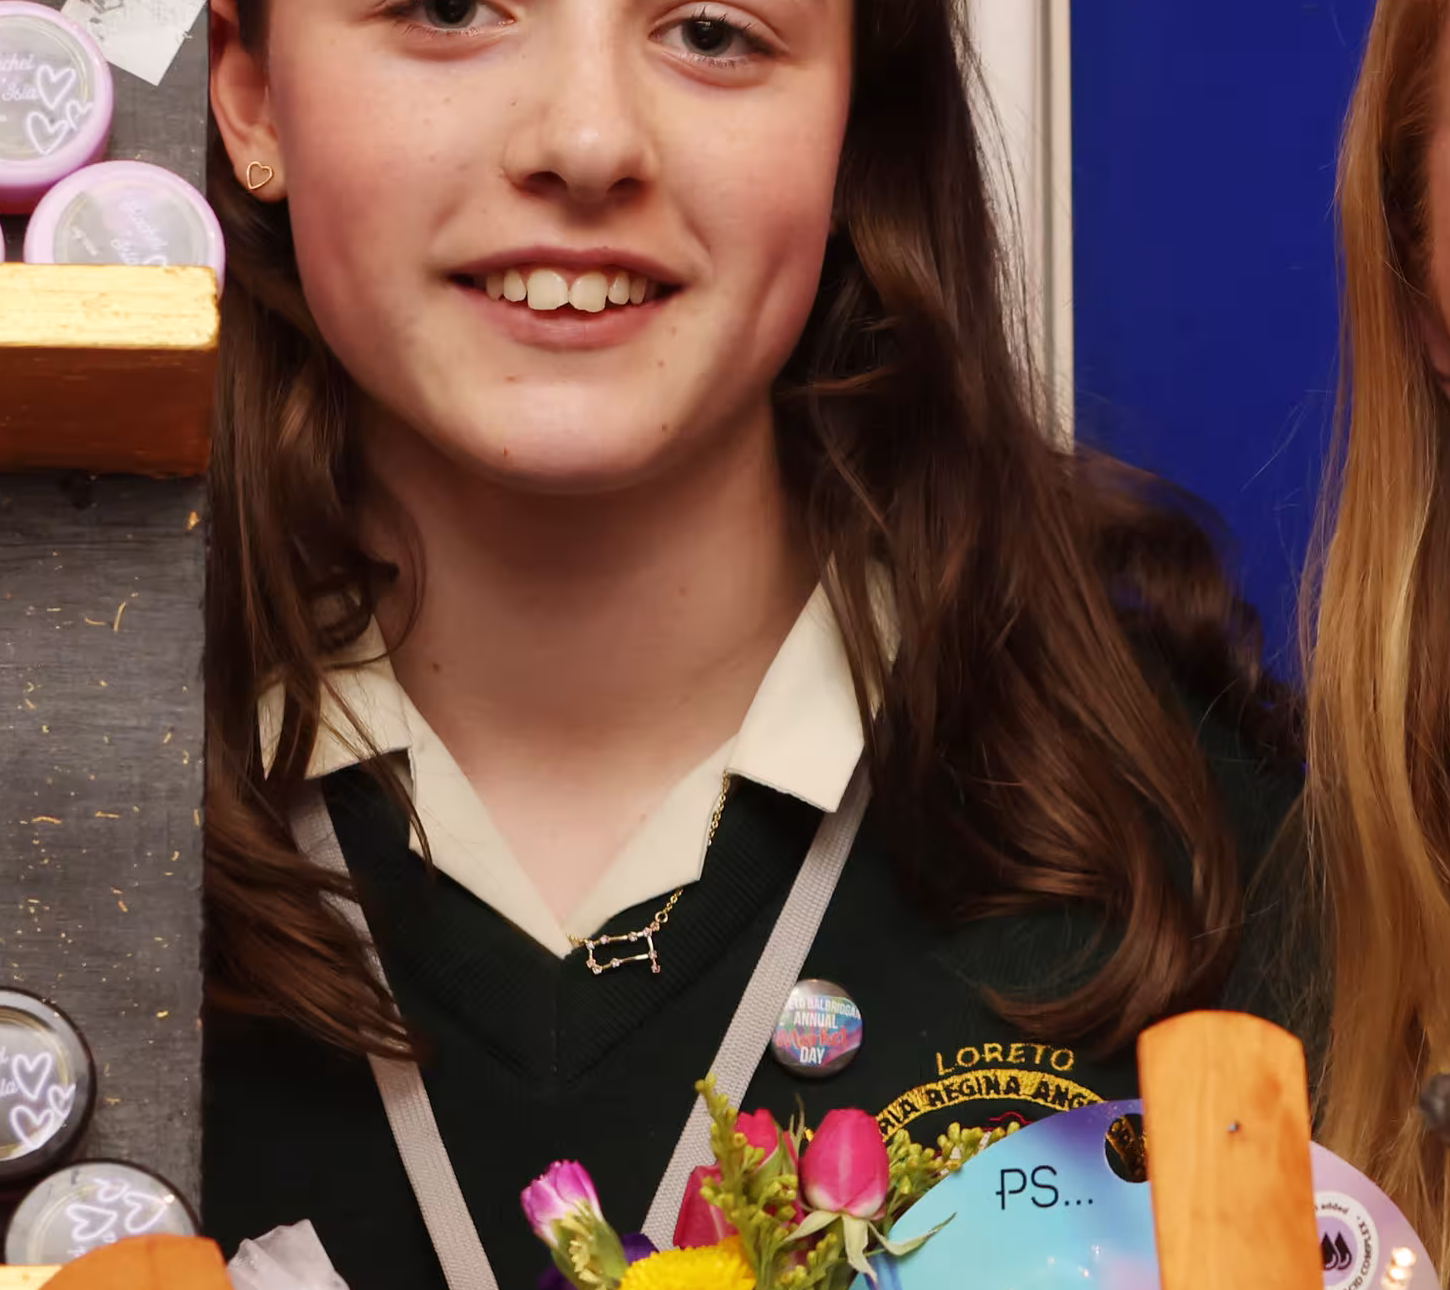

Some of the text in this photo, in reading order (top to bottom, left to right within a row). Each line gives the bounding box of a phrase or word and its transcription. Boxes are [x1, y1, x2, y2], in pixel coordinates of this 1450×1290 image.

[794, 1011, 838, 1029] ANNUAL
[800, 1046, 825, 1064] DAY
[936, 1042, 1075, 1076] LORETO
[880, 1097, 919, 1137] RIA
[926, 1076, 1023, 1108] REGINA
[996, 1165, 1094, 1210] PS...
